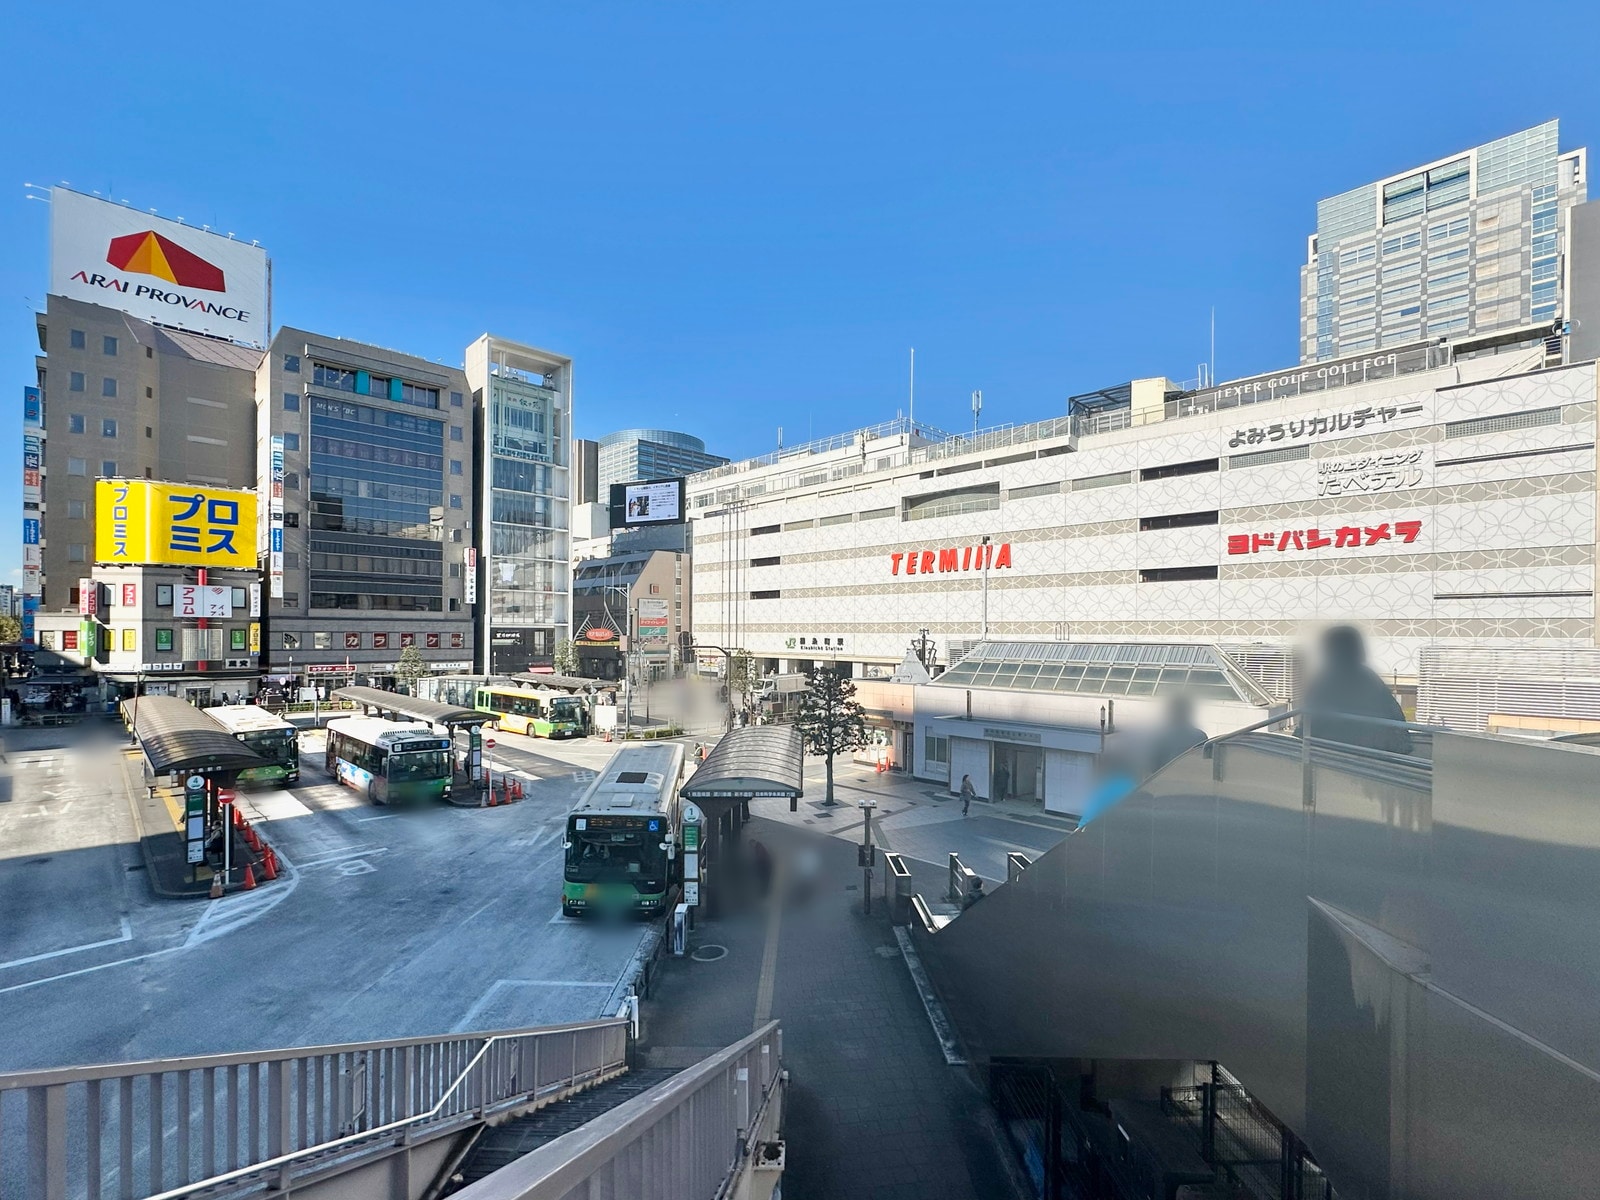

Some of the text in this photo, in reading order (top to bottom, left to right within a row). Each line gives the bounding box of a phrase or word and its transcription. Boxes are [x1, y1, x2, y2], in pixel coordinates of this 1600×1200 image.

[70, 270, 251, 323] ARAI PROVANCE
[1216, 353, 1397, 402] JEXER GOLF COLLEGE
[1228, 404, 1424, 448] よみうりカルチャー
[1318, 449, 1424, 475] 駅の上ダイニング
[1318, 466, 1424, 497] たべテル
[113, 487, 129, 557] プロミス
[1228, 520, 1423, 555] ヨドバシカメラ
[126, 585, 134, 604] アコム
[182, 586, 195, 615] アコム
[785, 637, 797, 649] JR
[689, 808, 694, 816] 1
